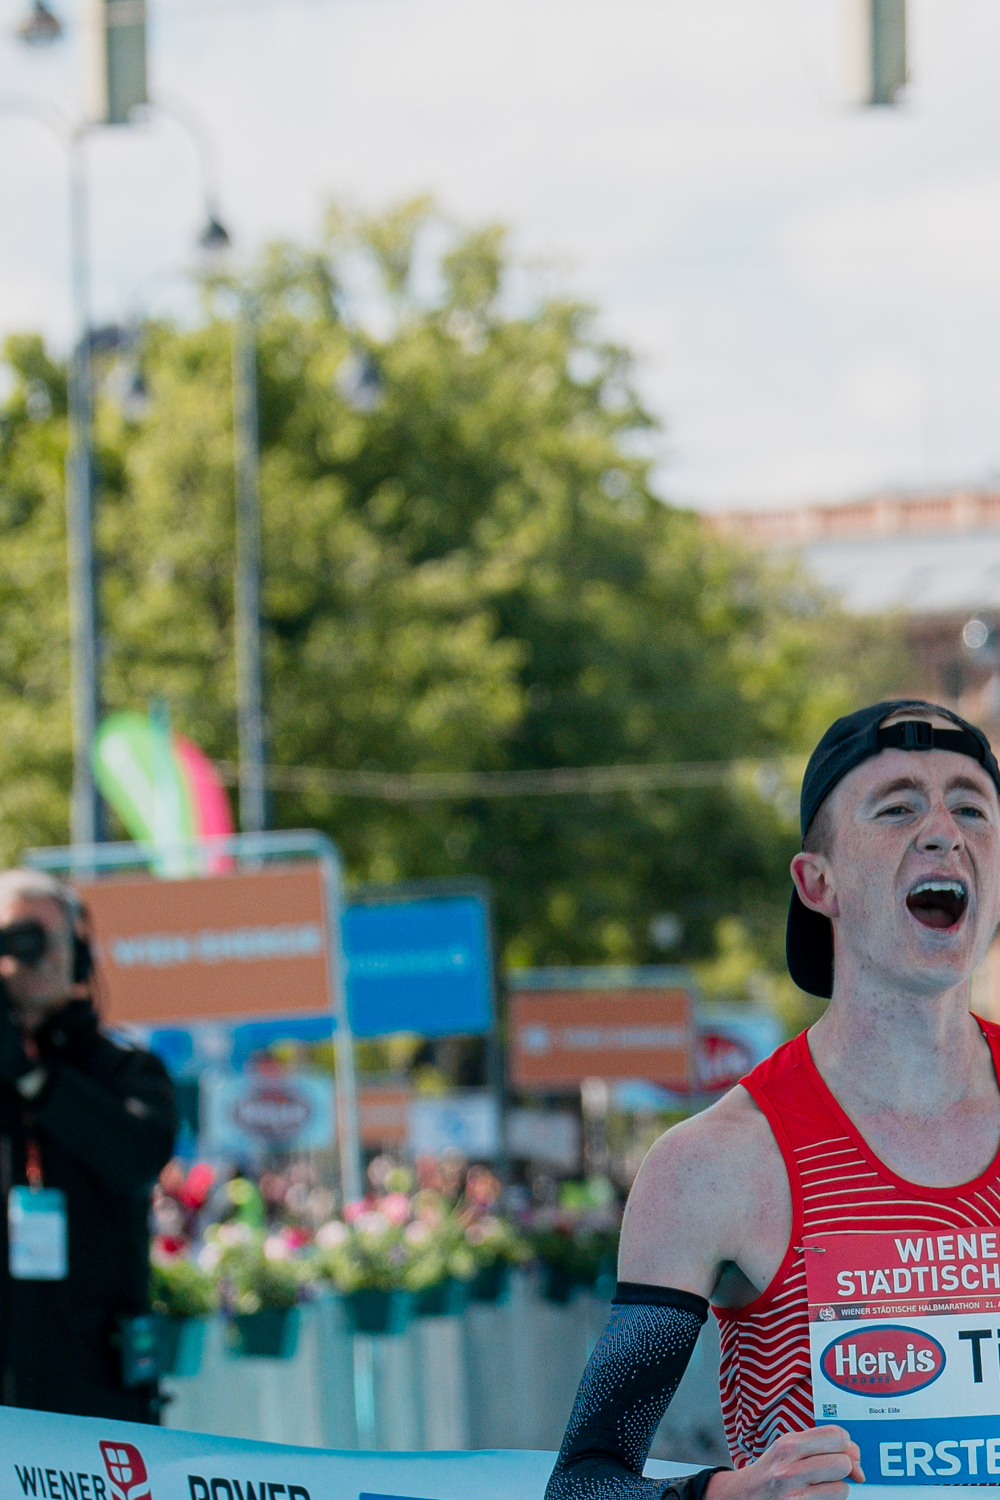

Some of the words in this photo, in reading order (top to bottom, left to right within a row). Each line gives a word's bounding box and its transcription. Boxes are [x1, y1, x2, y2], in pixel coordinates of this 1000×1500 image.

[840, 1307, 871, 1316] WIENER
[872, 1304, 917, 1315] STÄDTISCHE
[918, 1301, 980, 1312] HALBMARATHON
[985, 1301, 997, 1309] 21.
[834, 1343, 936, 1381] Hervis
[843, 1375, 891, 1386] SPORTS
